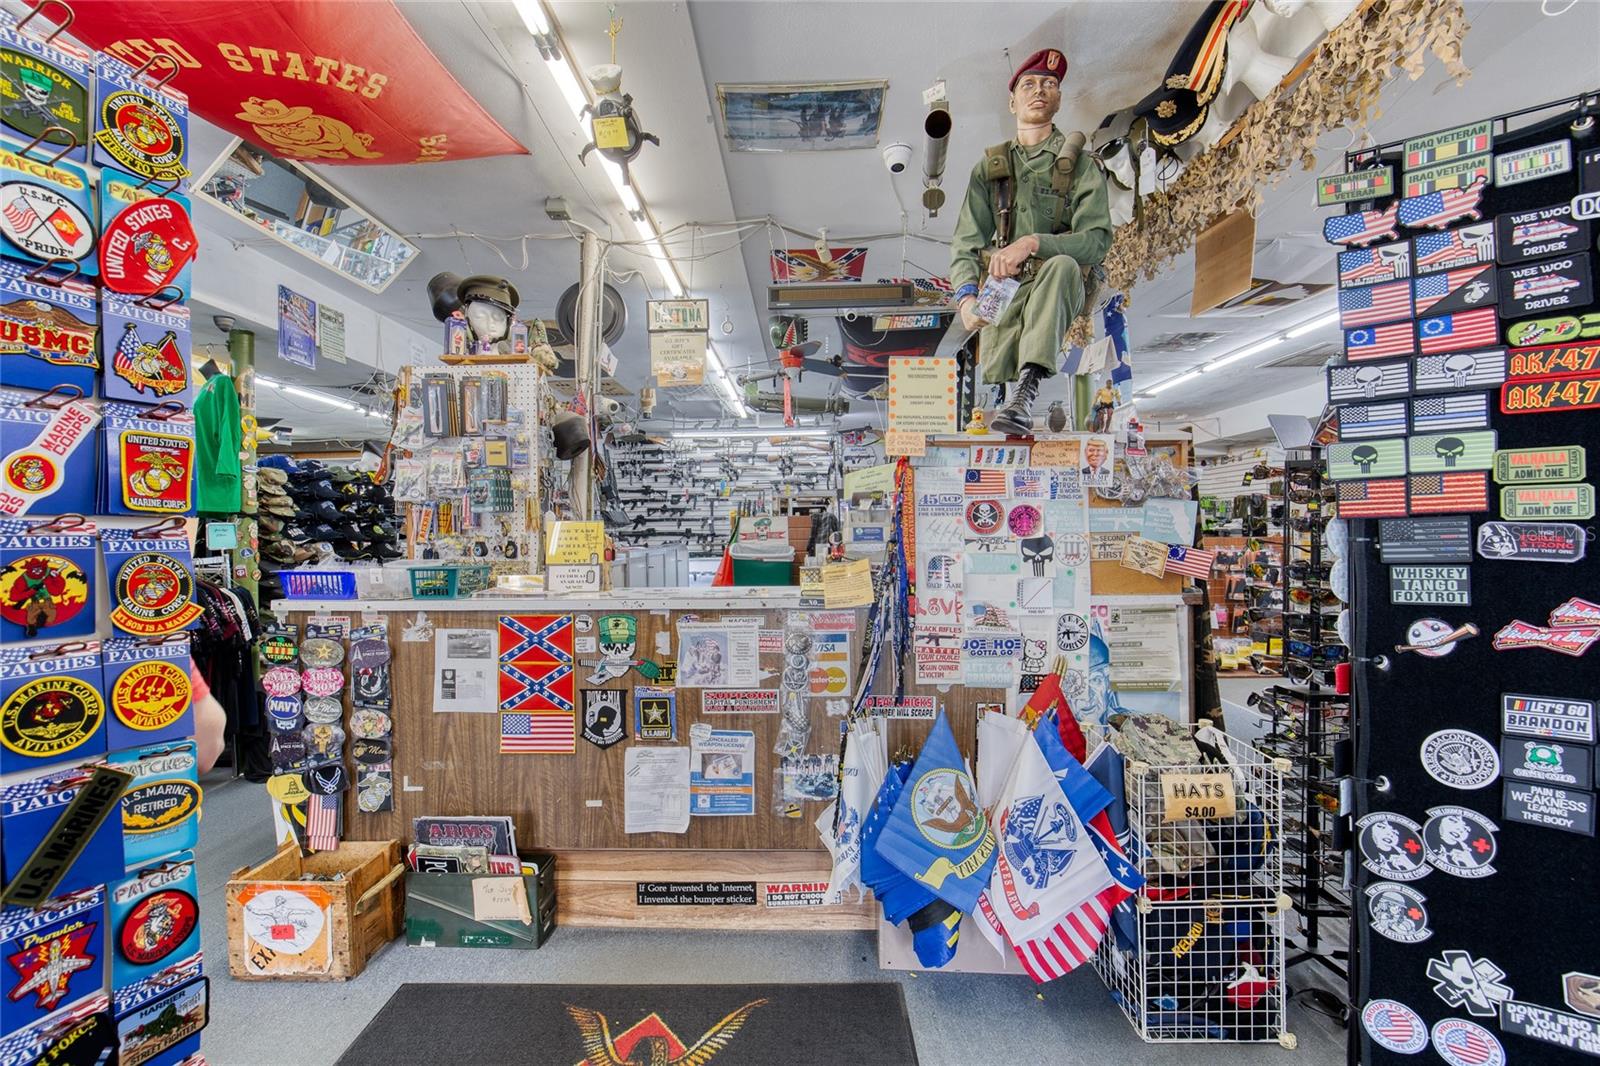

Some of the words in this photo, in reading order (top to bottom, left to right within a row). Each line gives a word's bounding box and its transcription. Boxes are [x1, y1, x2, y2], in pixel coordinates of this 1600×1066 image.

[0, 27, 86, 74] ATCHES
[1, 52, 72, 90] WARRIOR
[217, 43, 389, 99] STATES
[103, 67, 186, 115] PATCHES
[109, 96, 144, 111] UNITED
[151, 106, 179, 138] STATES
[114, 127, 146, 161] MARINE
[152, 152, 178, 164] CORPS
[1409, 138, 1434, 149] IRAQ
[1435, 125, 1487, 145] VETERAN
[100, 134, 134, 166] FIRST
[134, 161, 152, 174] TO
[1501, 151, 1532, 164] DESERT
[1533, 143, 1563, 157] STORM
[1322, 169, 1388, 186] AFGHANISTAN
[1408, 171, 1434, 183] IRAQ
[1435, 158, 1486, 178] VETERAN
[1502, 163, 1564, 182] VETERAN
[18, 186, 68, 208] U.S.M.C.
[1334, 188, 1376, 200] VETERAN
[1511, 213, 1538, 224] WEE
[1540, 206, 1571, 219] WOO
[105, 229, 130, 280] UNITED
[124, 203, 173, 231] STATES
[1523, 241, 1568, 256] DRIVER
[1511, 267, 1538, 279] WEE
[1541, 260, 1573, 274] WOO
[0, 276, 92, 308] PATCHES
[1524, 296, 1570, 311] DRIVER
[108, 303, 188, 328] PATCHES
[893, 315, 935, 328] NASCAR
[0, 320, 90, 355] USMC
[40, 406, 81, 453] MARINE
[53, 415, 92, 457] CORPS
[111, 418, 193, 436] PATCHES
[127, 434, 157, 447] UNITED
[157, 437, 189, 449] STATES
[1511, 451, 1567, 465] VALHALLA
[1514, 468, 1543, 479] ADMIT
[1544, 468, 1564, 478] ONE
[129, 497, 160, 508] MARINE
[161, 499, 187, 510] CORPS
[1518, 490, 1577, 503] VALHALLA
[1521, 505, 1551, 516] ADMIT
[1552, 505, 1573, 515] ONE
[0, 535, 91, 547] PATCHES
[109, 540, 188, 551] PATCHES
[121, 555, 151, 581] UNITED
[156, 556, 187, 580] STATES
[1393, 568, 1466, 579] WHISKEY
[1402, 580, 1458, 591] TANGO
[123, 596, 156, 618] MARINE
[161, 593, 187, 615] CORPS
[1395, 591, 1466, 603] FOXTROT
[127, 618, 144, 631] SON
[601, 643, 629, 655] WAR
[815, 643, 836, 652] VISA
[963, 639, 987, 649] JOE
[993, 638, 1021, 649] HOE
[108, 647, 187, 662] PATCHES
[0, 655, 97, 678] PATCHES
[125, 663, 162, 684] MARINE
[163, 666, 188, 698] CORPS
[272, 672, 295, 682] NAVY
[310, 672, 339, 682] ARMY
[272, 682, 295, 692] MOM
[312, 682, 336, 692] MOM
[704, 691, 777, 699] SUPPORT
[3, 700, 19, 728] U.S.
[16, 680, 72, 700] MARINE
[73, 683, 99, 716] CORPS
[270, 699, 300, 713] NAVY
[897, 708, 910, 717] WILL
[910, 708, 933, 717] SCRAPE
[1530, 702, 1563, 714] LET'S
[1567, 705, 1587, 717] GO
[132, 706, 177, 728] AVIATION
[1507, 714, 1588, 732] BRANDON
[14, 729, 87, 752] AVIATION
[1432, 732, 1466, 748] BACON
[1472, 740, 1493, 762] GUNS
[1424, 752, 1444, 778] BEER
[1448, 766, 1493, 785] FREEDOM
[146, 783, 191, 798] MARINE
[1173, 783, 1225, 799] HATS
[1531, 786, 1553, 796] PAIN
[1555, 789, 1566, 798] IS
[133, 797, 178, 814] RETIRED
[1511, 790, 1588, 813] WEAKNESS
[1527, 802, 1568, 817] LEAVING
[44, 774, 122, 863] MARINES
[1185, 806, 1216, 818] $4.00
[1522, 811, 1542, 822] THE
[1543, 814, 1574, 828] BODY
[429, 823, 494, 838] ARMS
[1435, 857, 1461, 875] FASTER
[639, 884, 645, 892] If
[647, 884, 667, 893] Gore
[670, 884, 704, 893] invented
[706, 884, 720, 893] the
[722, 884, 755, 895] Internet,
[643, 895, 678, 903] invented
[679, 895, 693, 903] the
[693, 895, 725, 906] bumper
[726, 895, 755, 903] sticker.
[1006, 890, 1025, 914] ARMY
[23, 920, 86, 949] Prowler
[139, 990, 186, 1019] HARRIER
[1366, 1003, 1386, 1023] PROUD
[1388, 1003, 1401, 1013] TO
[1402, 1009, 1416, 1024] BE
[1507, 1002, 1553, 1020] DON'T
[1556, 1013, 1593, 1032] BRO
[1510, 1012, 1526, 1024] IF
[1531, 1017, 1564, 1033] YOU
[163, 1024, 197, 1048] FIGHTER
[1385, 1030, 1424, 1053] AMERICAN
[1438, 1022, 1468, 1035] PROUD
[1472, 1027, 1485, 1039] TO
[1486, 1037, 1498, 1051] BE
[1525, 1024, 1574, 1047] KNOW
